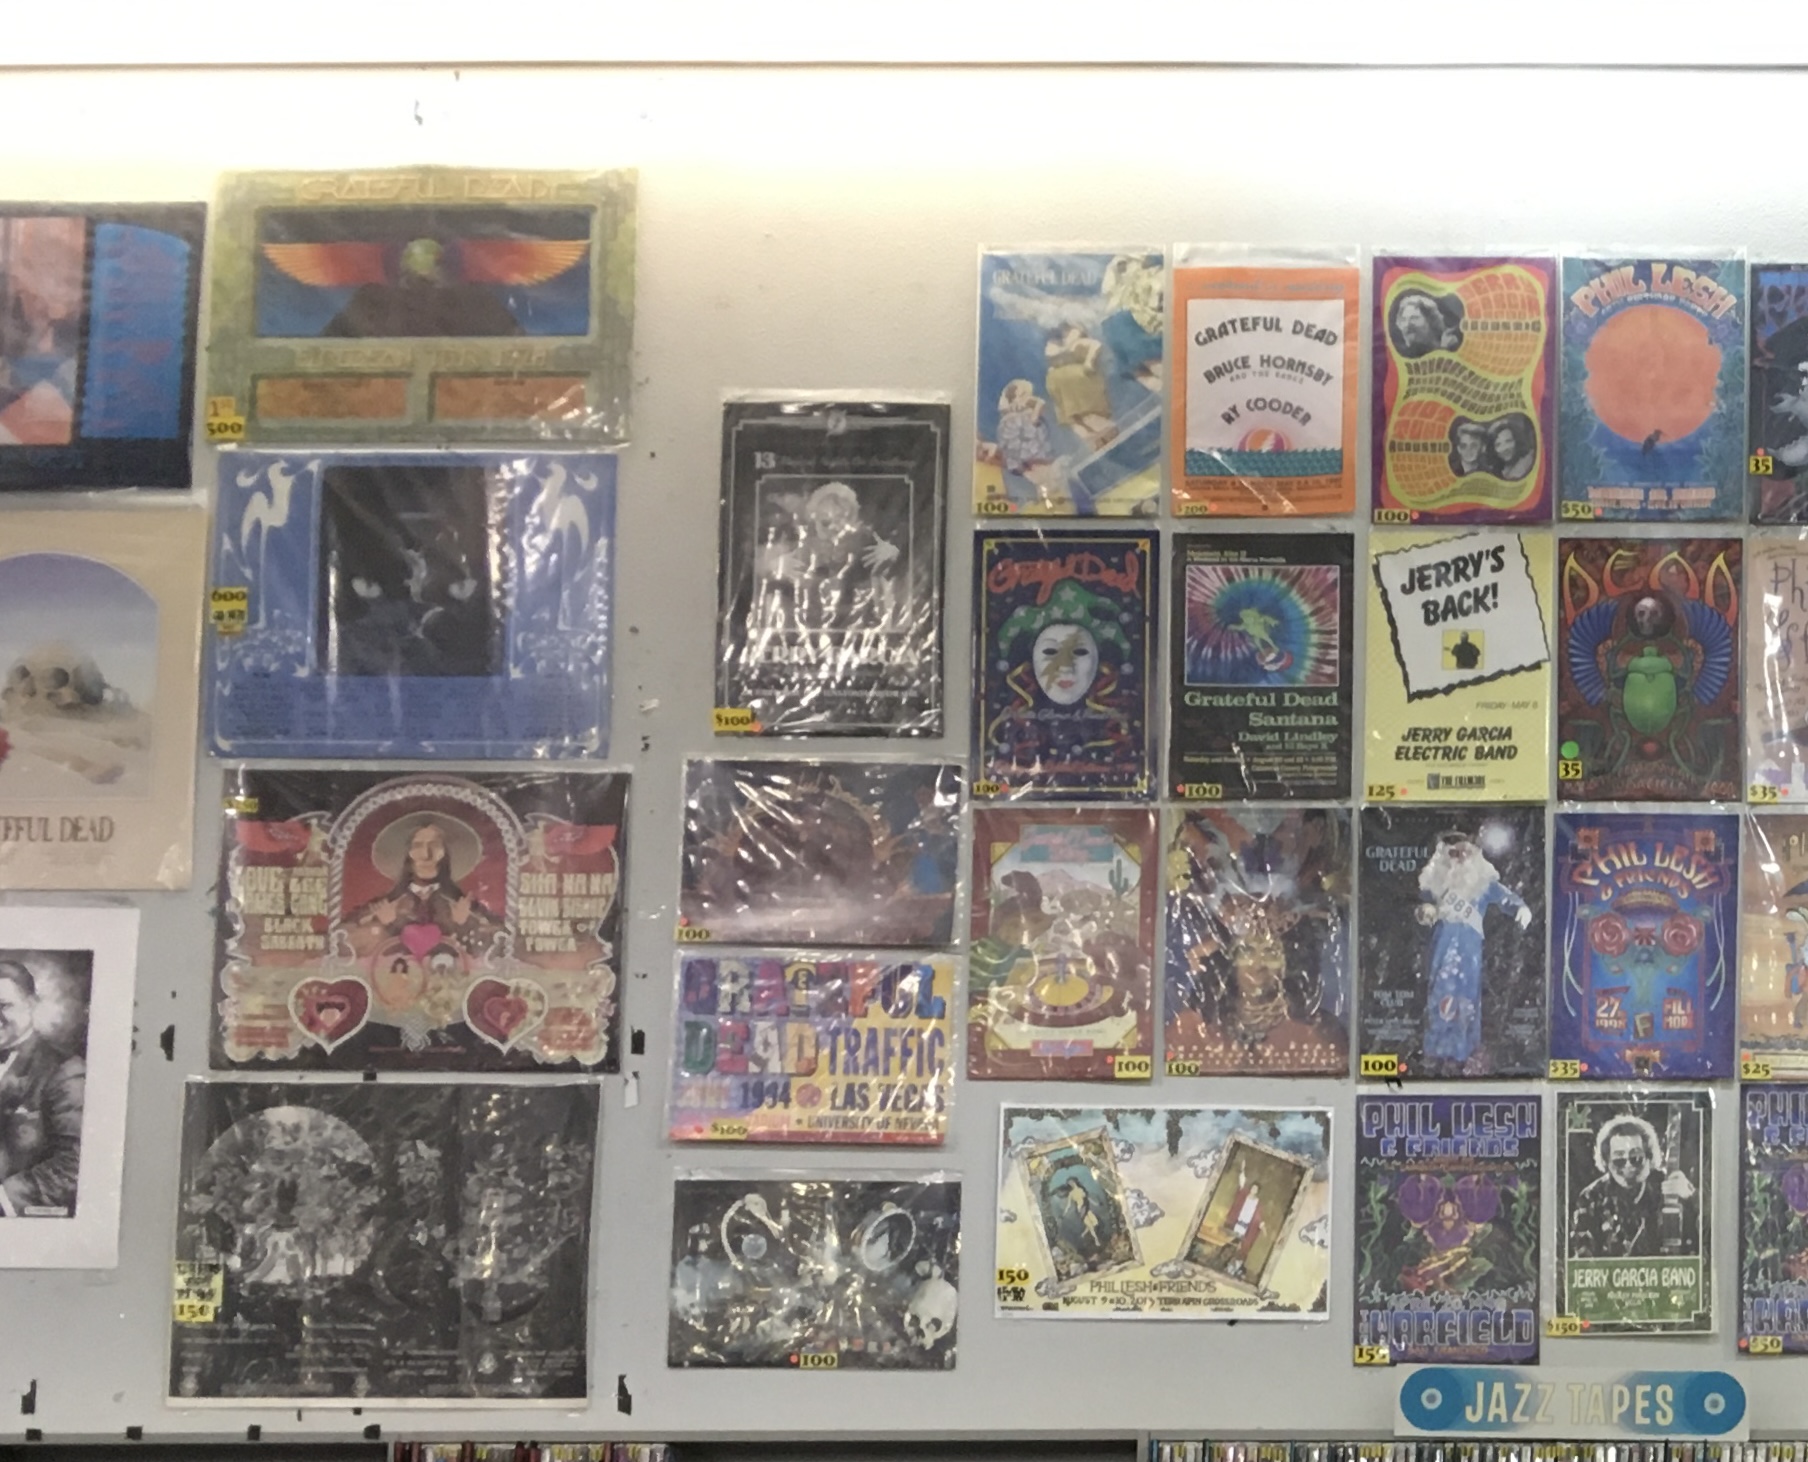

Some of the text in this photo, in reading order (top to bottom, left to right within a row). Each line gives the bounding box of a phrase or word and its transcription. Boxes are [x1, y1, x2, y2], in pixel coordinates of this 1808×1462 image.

[1571, 263, 1738, 319] PHIL LESH
[1194, 316, 1338, 347] GRATEFUL DEAD
[1203, 355, 1334, 387] BRUCE HORNSBY
[1221, 397, 1312, 426] RY COODER
[1751, 458, 1771, 472] 35
[1562, 502, 1592, 515] $50
[1375, 510, 1409, 522] 100
[1401, 544, 1505, 595] JERRY'S
[1421, 583, 1499, 626] BACK!
[1184, 691, 1338, 707] Grateful Dead
[716, 712, 750, 725] $100
[1249, 712, 1338, 726] Santana
[1238, 732, 1338, 743] David Lindley
[1401, 726, 1513, 742] JERRY GARCIA
[1395, 746, 1518, 763] ELECTRIC BAND
[1560, 763, 1581, 778] 35
[1187, 785, 1220, 796] 100
[1368, 784, 1395, 797] 125
[1750, 786, 1778, 800] $35
[1366, 846, 1431, 860] GRATEFUL
[1379, 860, 1417, 872] DEAD
[678, 928, 710, 940] 100
[828, 1026, 945, 1077] TRAFFIC
[1117, 1060, 1149, 1073] 100
[1363, 1059, 1396, 1072] 100
[1551, 1062, 1579, 1075] $35
[1742, 1063, 1770, 1075] $25
[830, 1081, 945, 1111] LAS VEGAS
[1363, 1102, 1538, 1139] PHIL LESH
[710, 1122, 747, 1136] $100
[997, 1268, 1029, 1281] 150
[1572, 1267, 1696, 1289] JERRY GARCIA BAND
[1548, 1321, 1578, 1332] $150
[802, 1354, 836, 1367] 100
[1465, 1381, 1675, 1427] JAZZ TAPES
